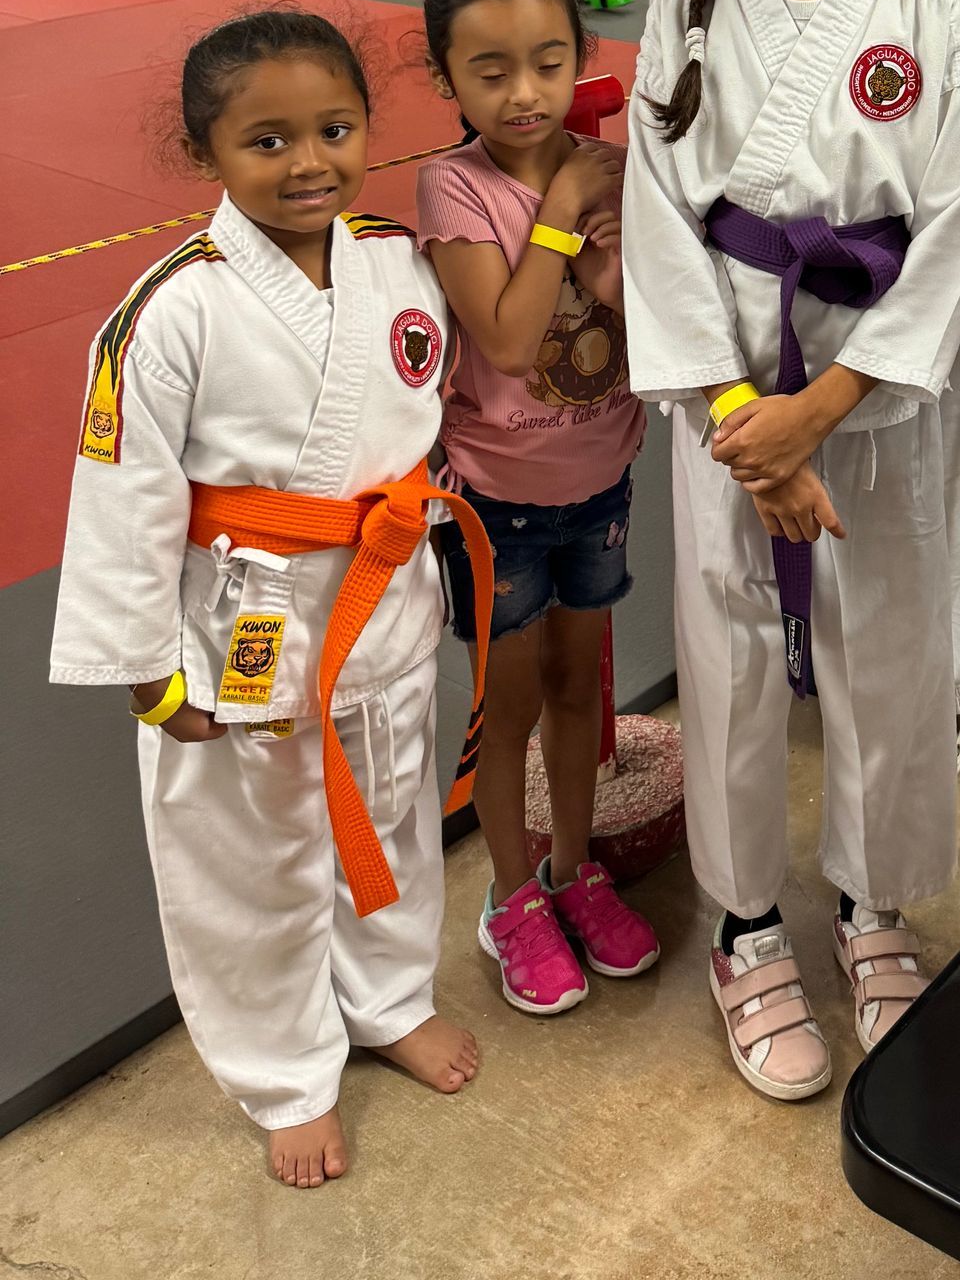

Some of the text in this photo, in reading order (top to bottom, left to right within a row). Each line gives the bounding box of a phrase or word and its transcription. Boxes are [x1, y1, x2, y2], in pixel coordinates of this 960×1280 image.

[866, 49, 916, 90] JAGUAR DOJO
[396, 314, 438, 344] JAGUAR DOJO
[85, 444, 113, 458] KWON
[240, 620, 281, 633] KWON
[223, 685, 267, 695] TIGER
[248, 694, 265, 702] BASIC
[586, 872, 605, 887] FILA
[524, 897, 545, 913] FILA
